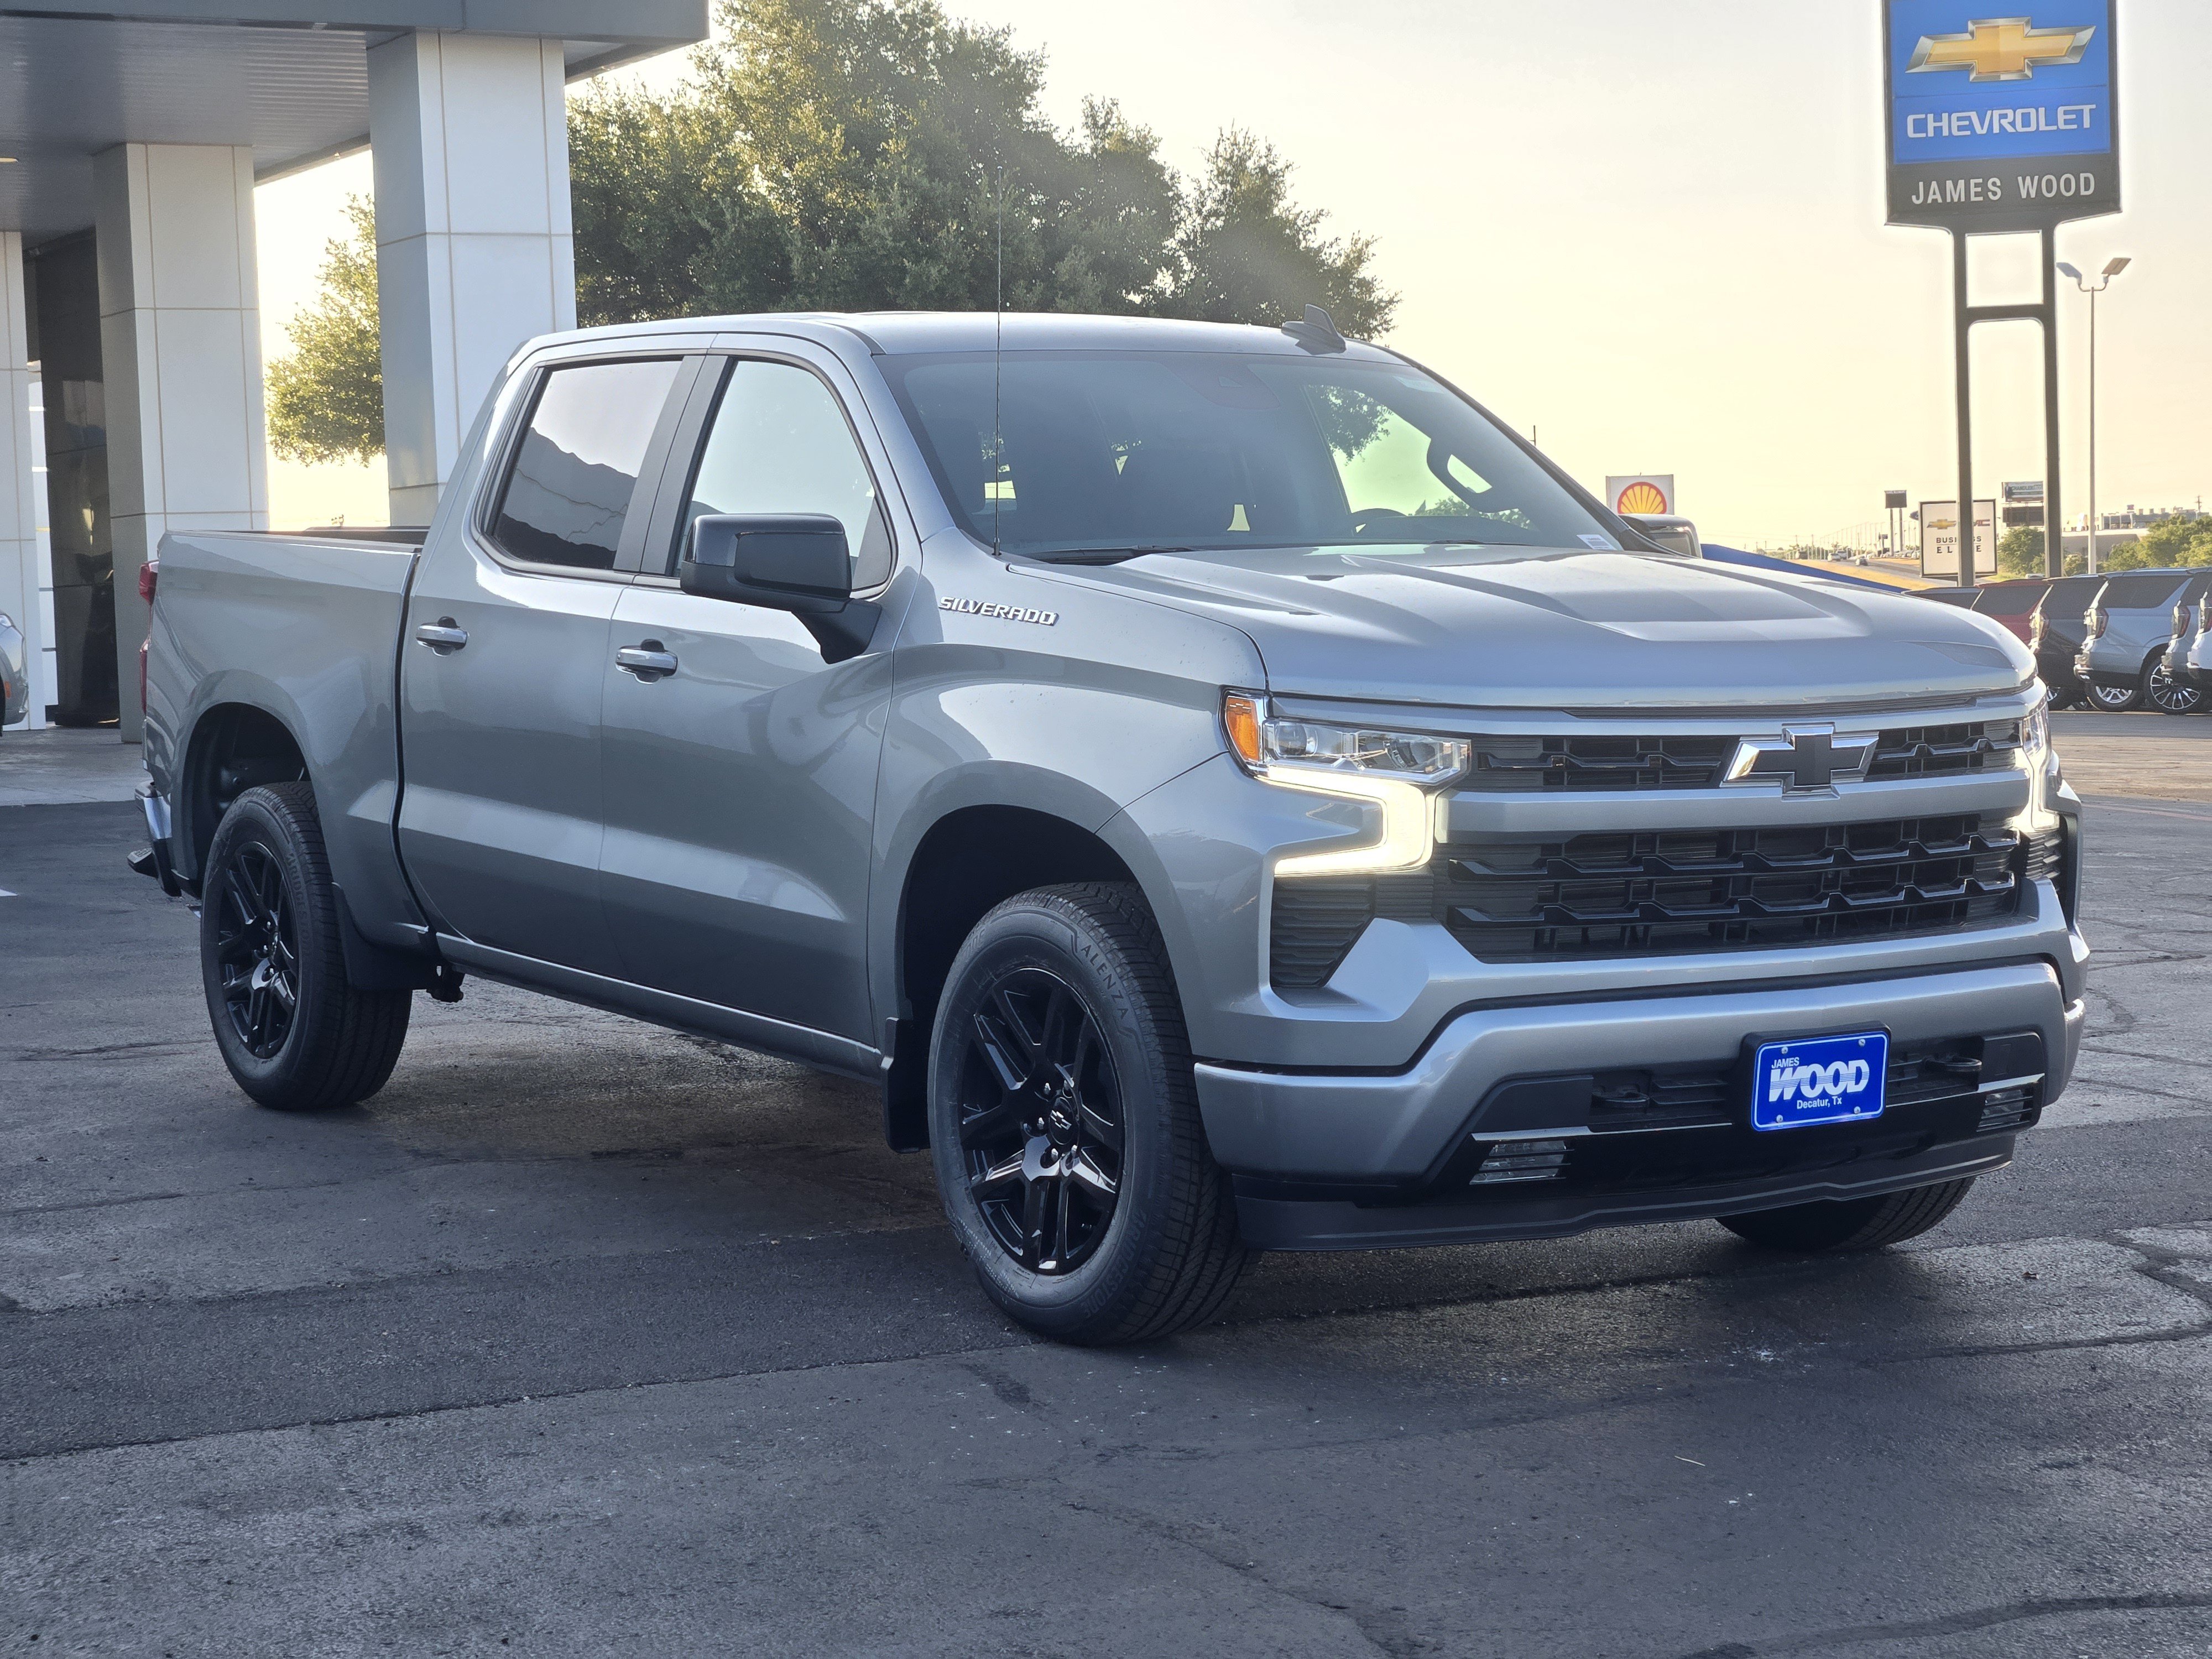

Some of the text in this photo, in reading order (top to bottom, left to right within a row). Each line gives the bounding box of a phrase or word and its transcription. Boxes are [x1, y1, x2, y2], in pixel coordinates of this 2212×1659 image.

[1907, 104, 2096, 138] CHEVROLET
[1911, 173, 2095, 204] JAMES WOOD
[1936, 545, 1982, 554] ELE
[939, 596, 1059, 626] SILVERADO
[1081, 945, 1129, 1019] ALENZA
[1771, 1057, 1799, 1069] JAMES
[1769, 1059, 1870, 1102] WOOD
[1797, 1096, 1842, 1109] Decatur, Tx
